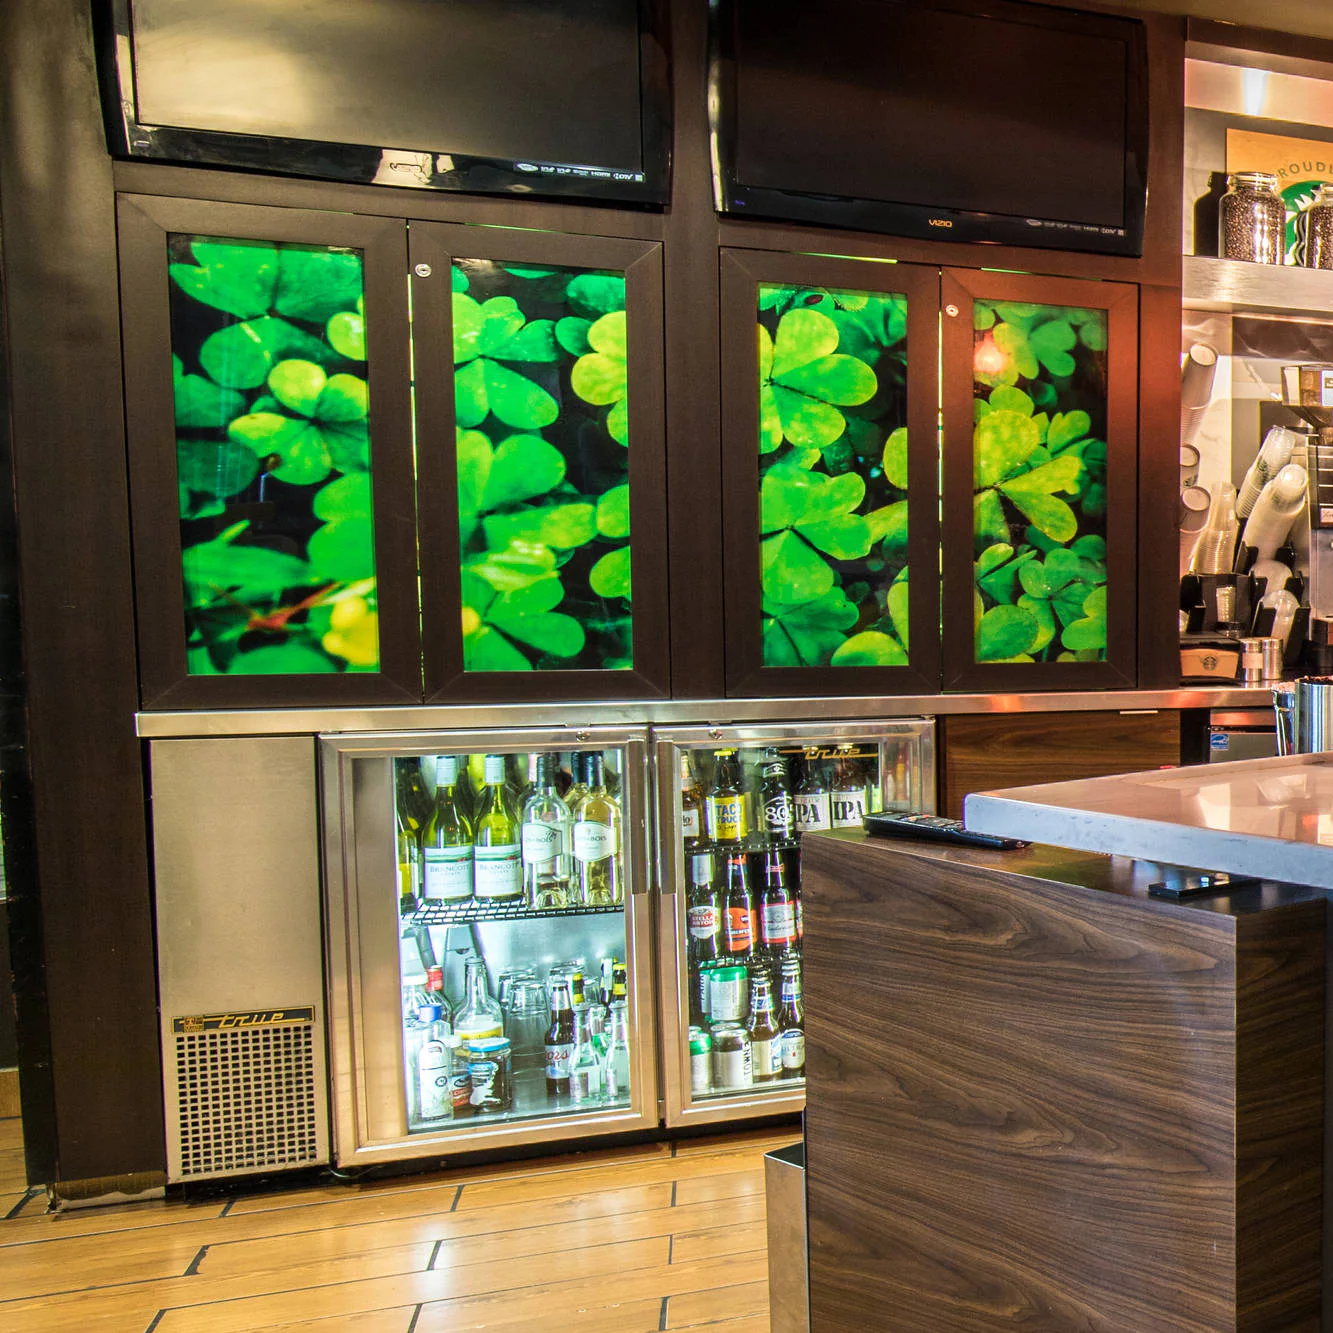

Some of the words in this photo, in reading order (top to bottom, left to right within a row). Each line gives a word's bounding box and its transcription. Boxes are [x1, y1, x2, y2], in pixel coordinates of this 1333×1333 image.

[928, 218, 953, 228] VIZIO
[714, 803, 742, 817] TACO
[795, 803, 821, 824] PA
[833, 800, 863, 822] IPA
[691, 913, 714, 922] STELLA
[218, 1011, 285, 1030] true
